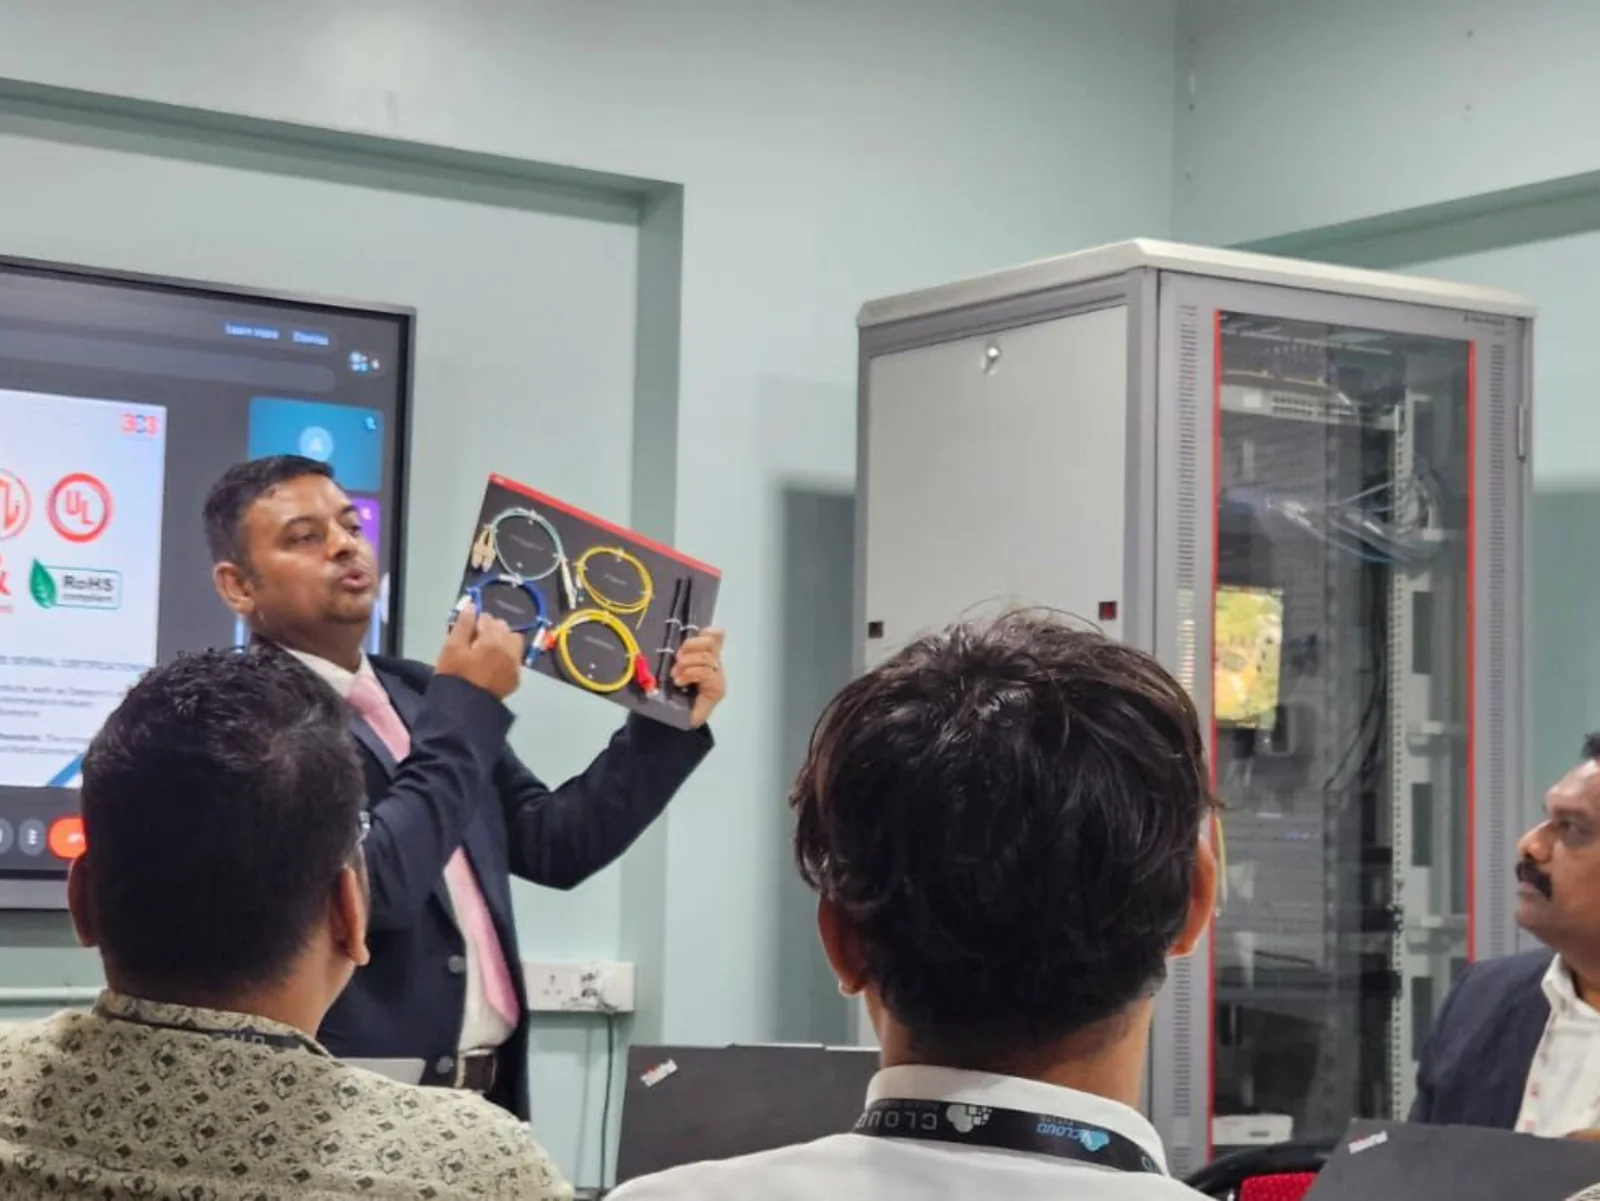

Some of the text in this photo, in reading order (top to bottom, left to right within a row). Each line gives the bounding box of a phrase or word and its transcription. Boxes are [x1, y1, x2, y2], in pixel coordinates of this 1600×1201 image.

[65, 490, 94, 525] UL
[63, 575, 113, 592] RoHS
[855, 1112, 938, 1130] CLOUD
